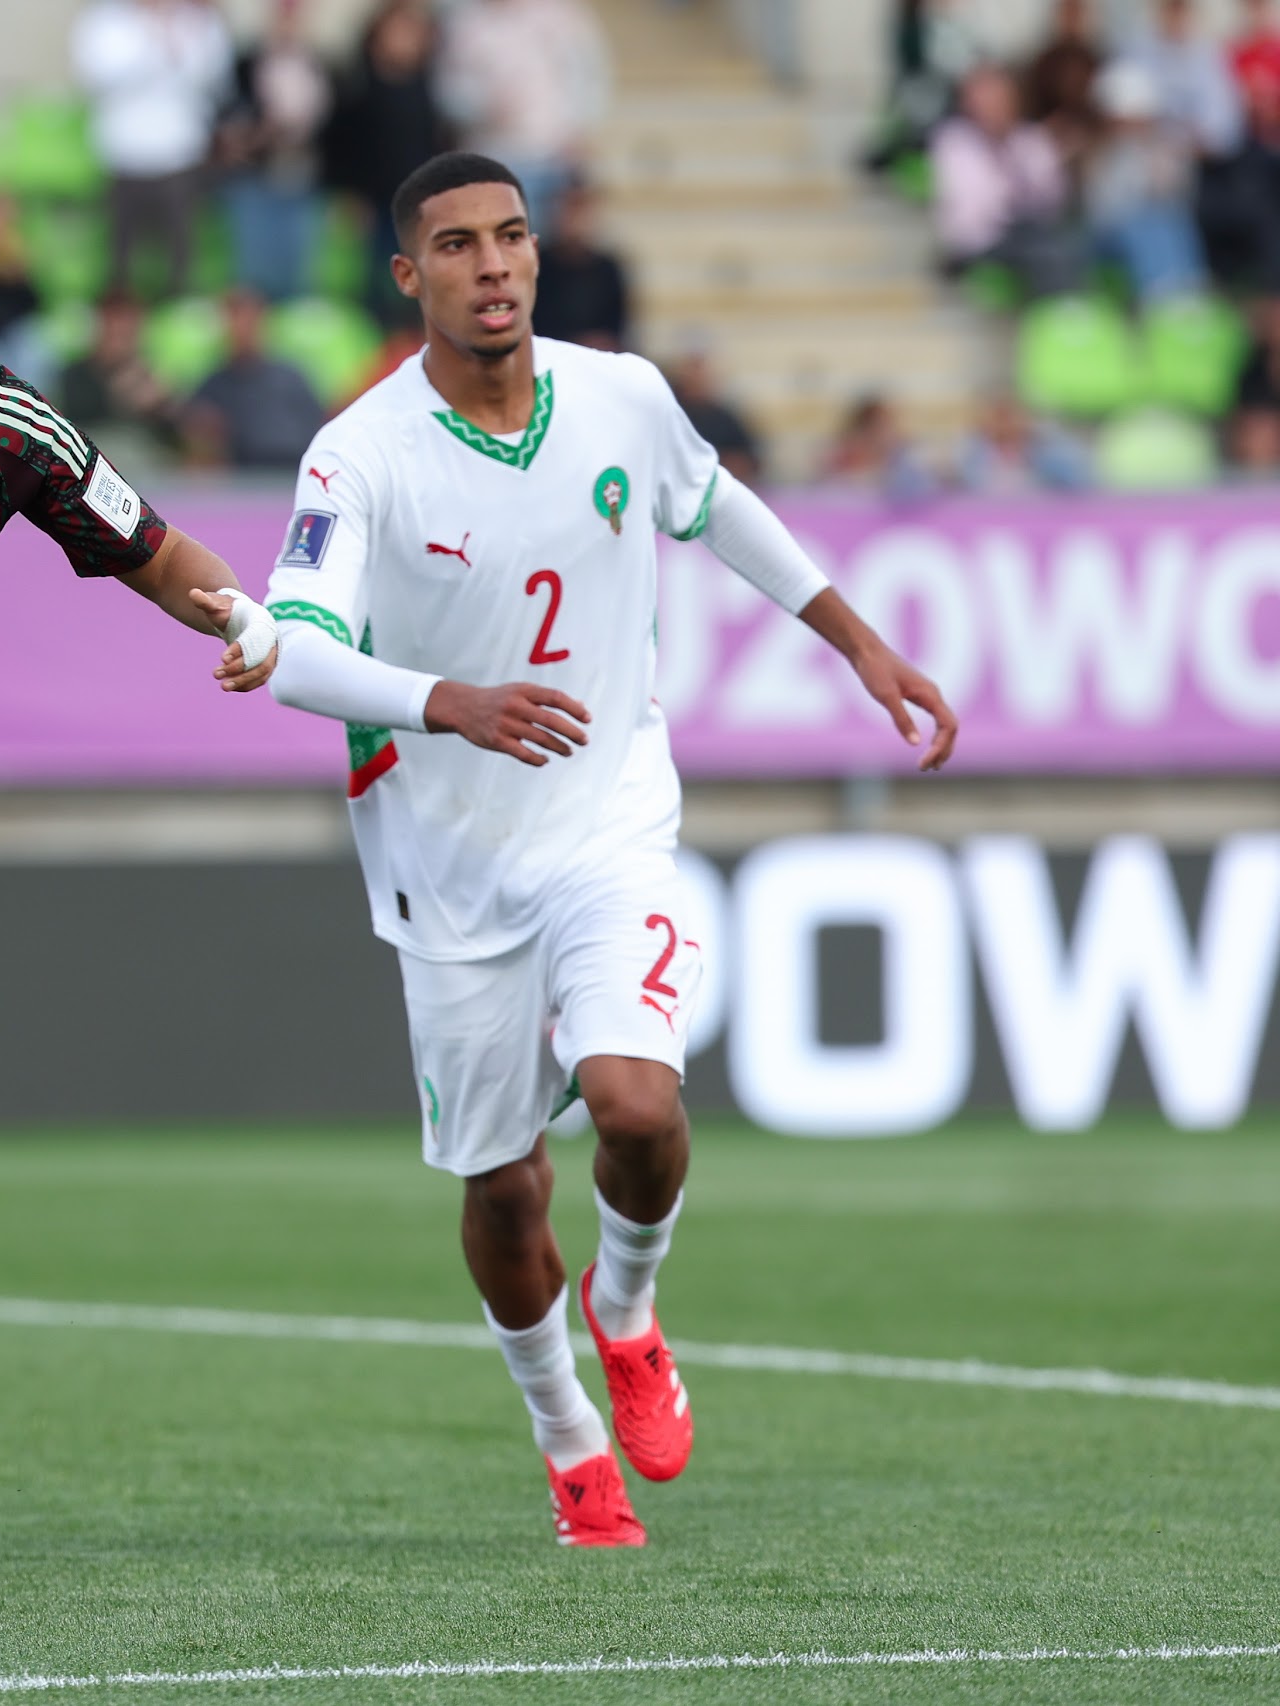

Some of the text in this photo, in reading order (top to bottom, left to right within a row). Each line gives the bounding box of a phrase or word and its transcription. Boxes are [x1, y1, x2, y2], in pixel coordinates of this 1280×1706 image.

[101, 479, 116, 507] UNITES
[525, 569, 570, 665] 2
[641, 913, 678, 998] 2
